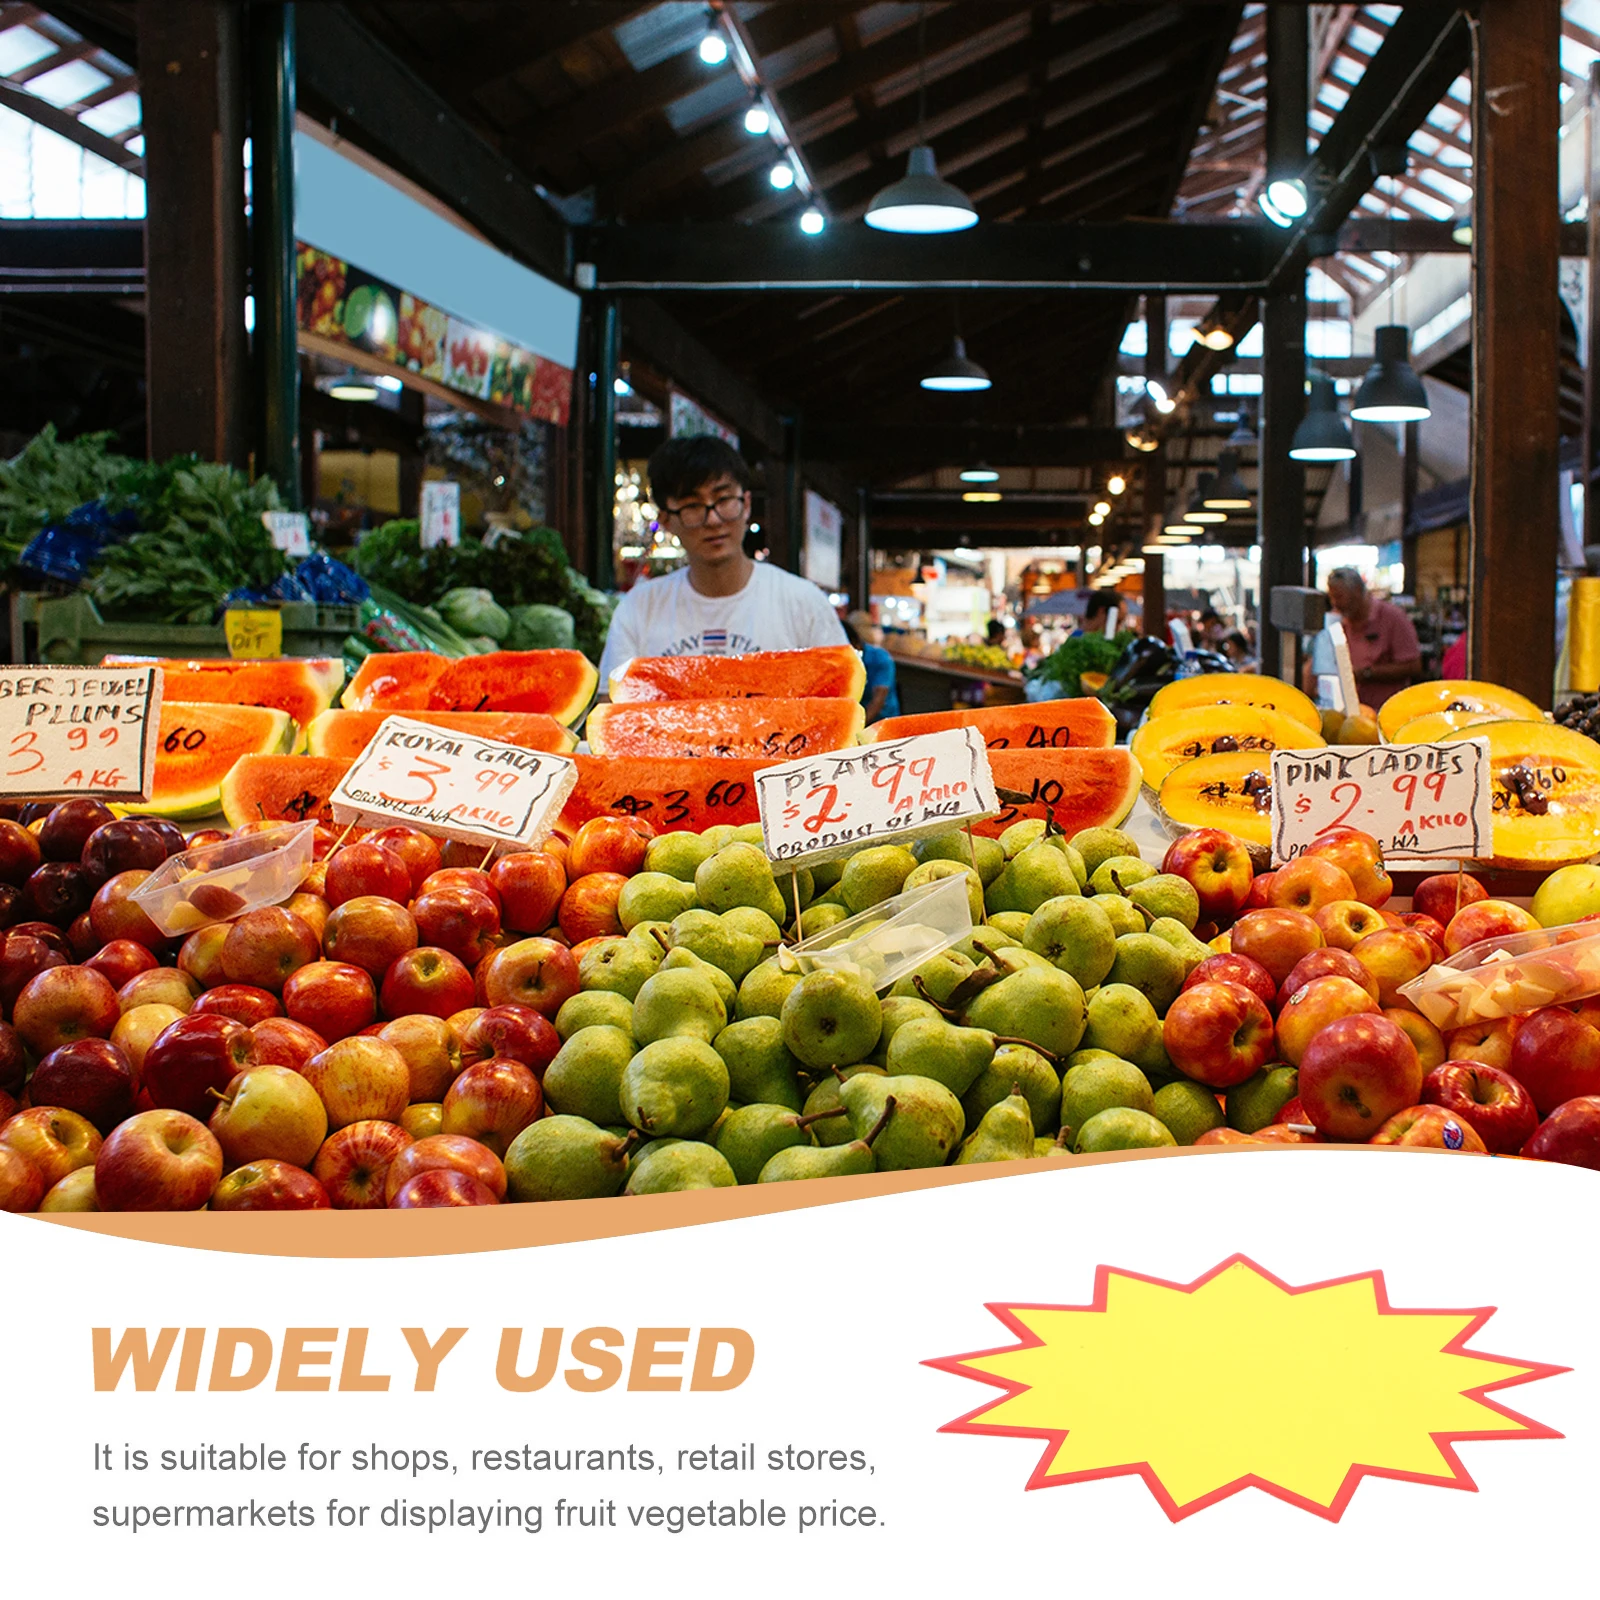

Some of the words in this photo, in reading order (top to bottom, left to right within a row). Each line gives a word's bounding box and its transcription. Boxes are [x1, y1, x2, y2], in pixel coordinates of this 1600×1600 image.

[25, 702, 144, 726] PLUMS
[385, 731, 463, 757] ROYAL
[474, 749, 542, 777] GALA
[784, 749, 905, 797] PEARS
[1287, 755, 1353, 786] PINK
[1368, 750, 1464, 776] LADIES
[776, 823, 874, 859] PRODUCT
[886, 812, 913, 828] OF
